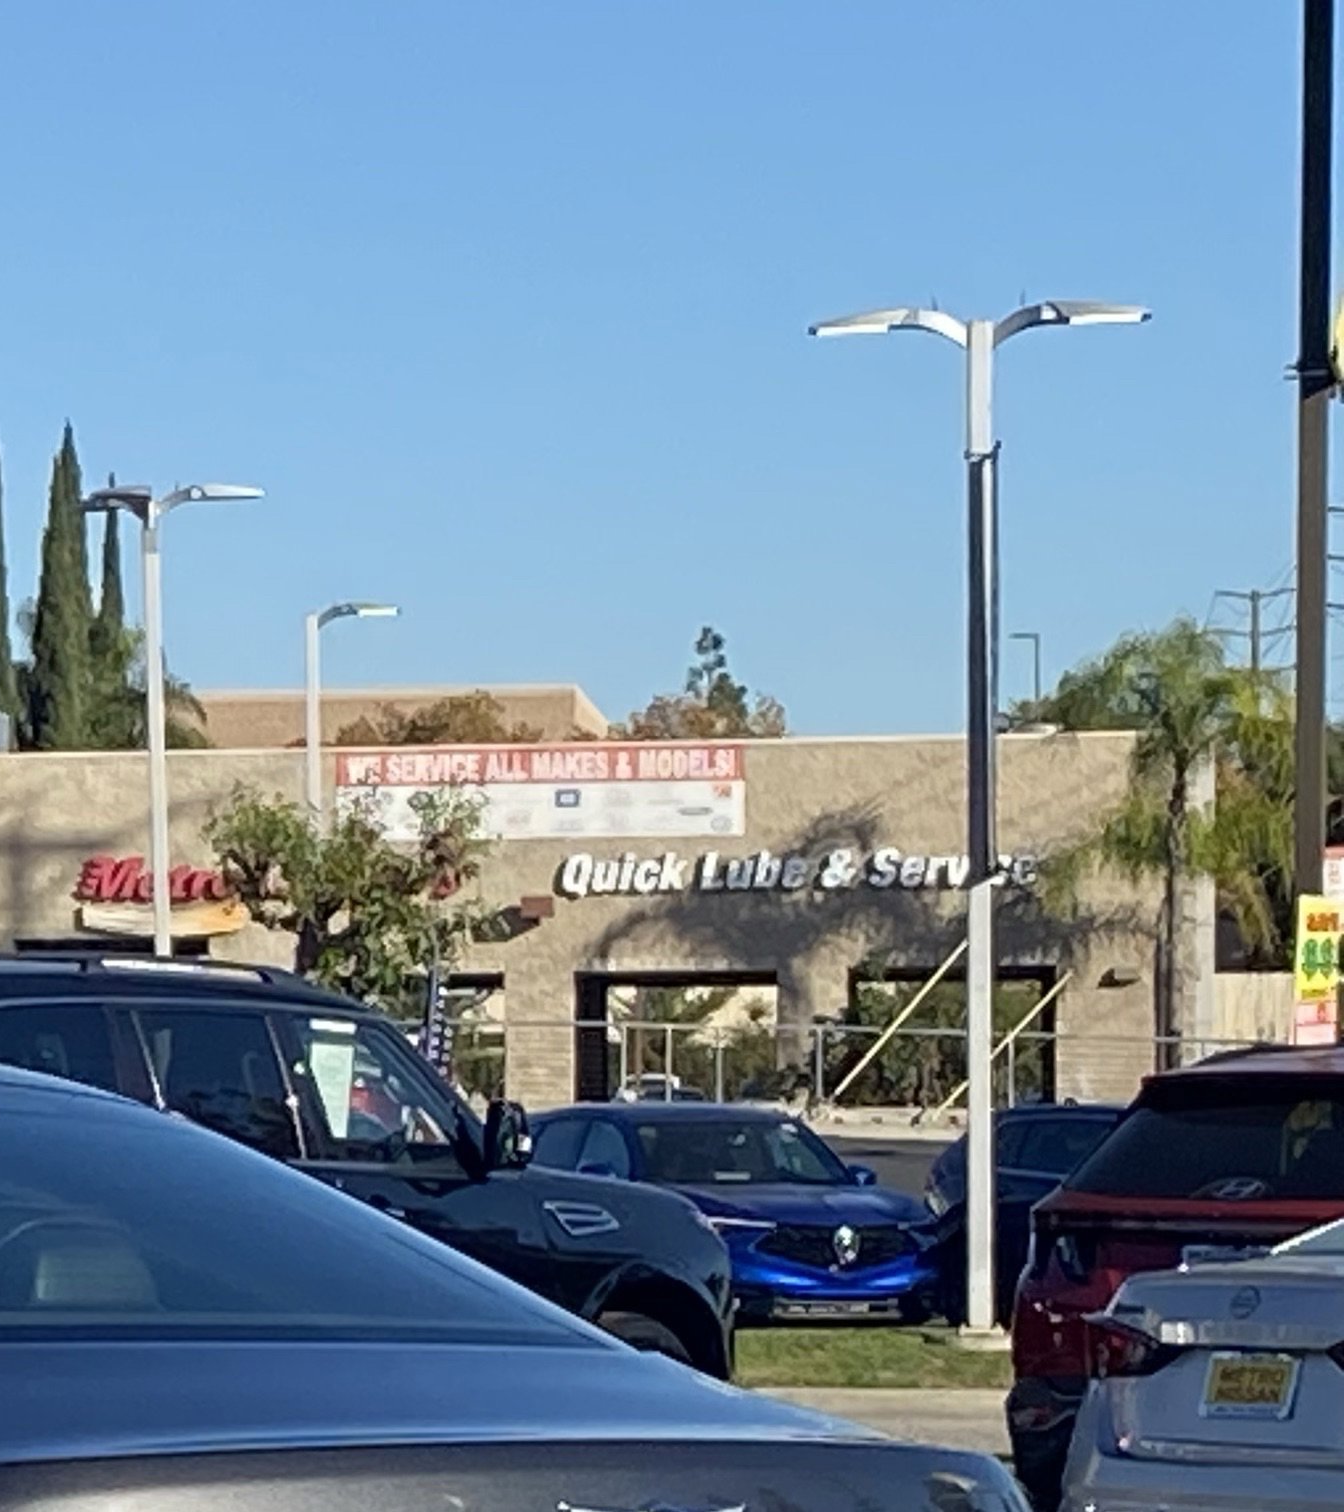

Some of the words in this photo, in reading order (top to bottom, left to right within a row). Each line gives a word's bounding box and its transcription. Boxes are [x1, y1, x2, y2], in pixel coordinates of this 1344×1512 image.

[385, 754, 482, 783] SERVICE
[484, 753, 529, 781] ALL
[531, 751, 610, 780] MAKES
[614, 751, 633, 779] &
[559, 850, 690, 897] Quick
[699, 849, 808, 891] Lube
[820, 848, 859, 890] &
[869, 846, 1038, 889] Servce
